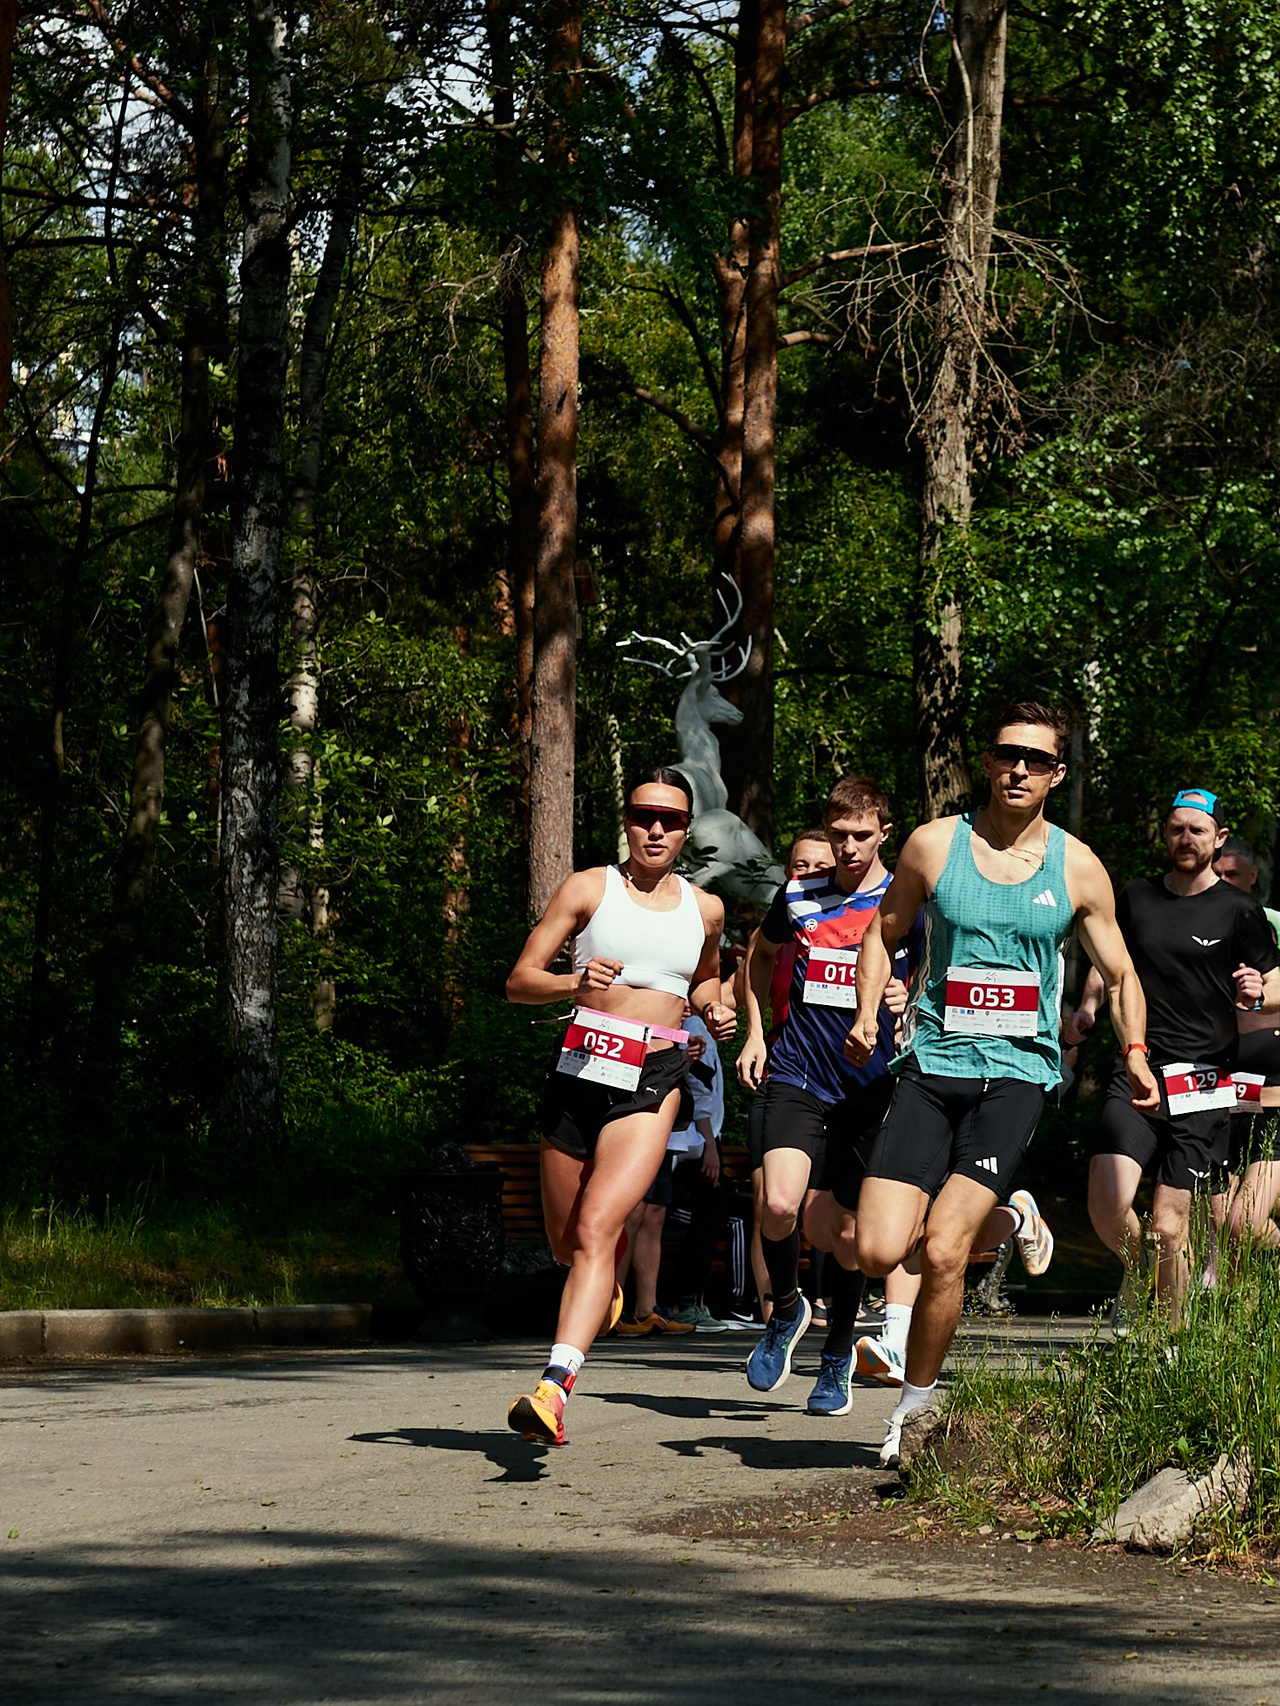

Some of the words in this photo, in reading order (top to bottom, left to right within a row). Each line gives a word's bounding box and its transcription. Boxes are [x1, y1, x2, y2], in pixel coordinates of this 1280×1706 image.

[969, 986, 1015, 1008] 053
[583, 1031, 625, 1059] 052
[1184, 1071, 1217, 1090] 129
